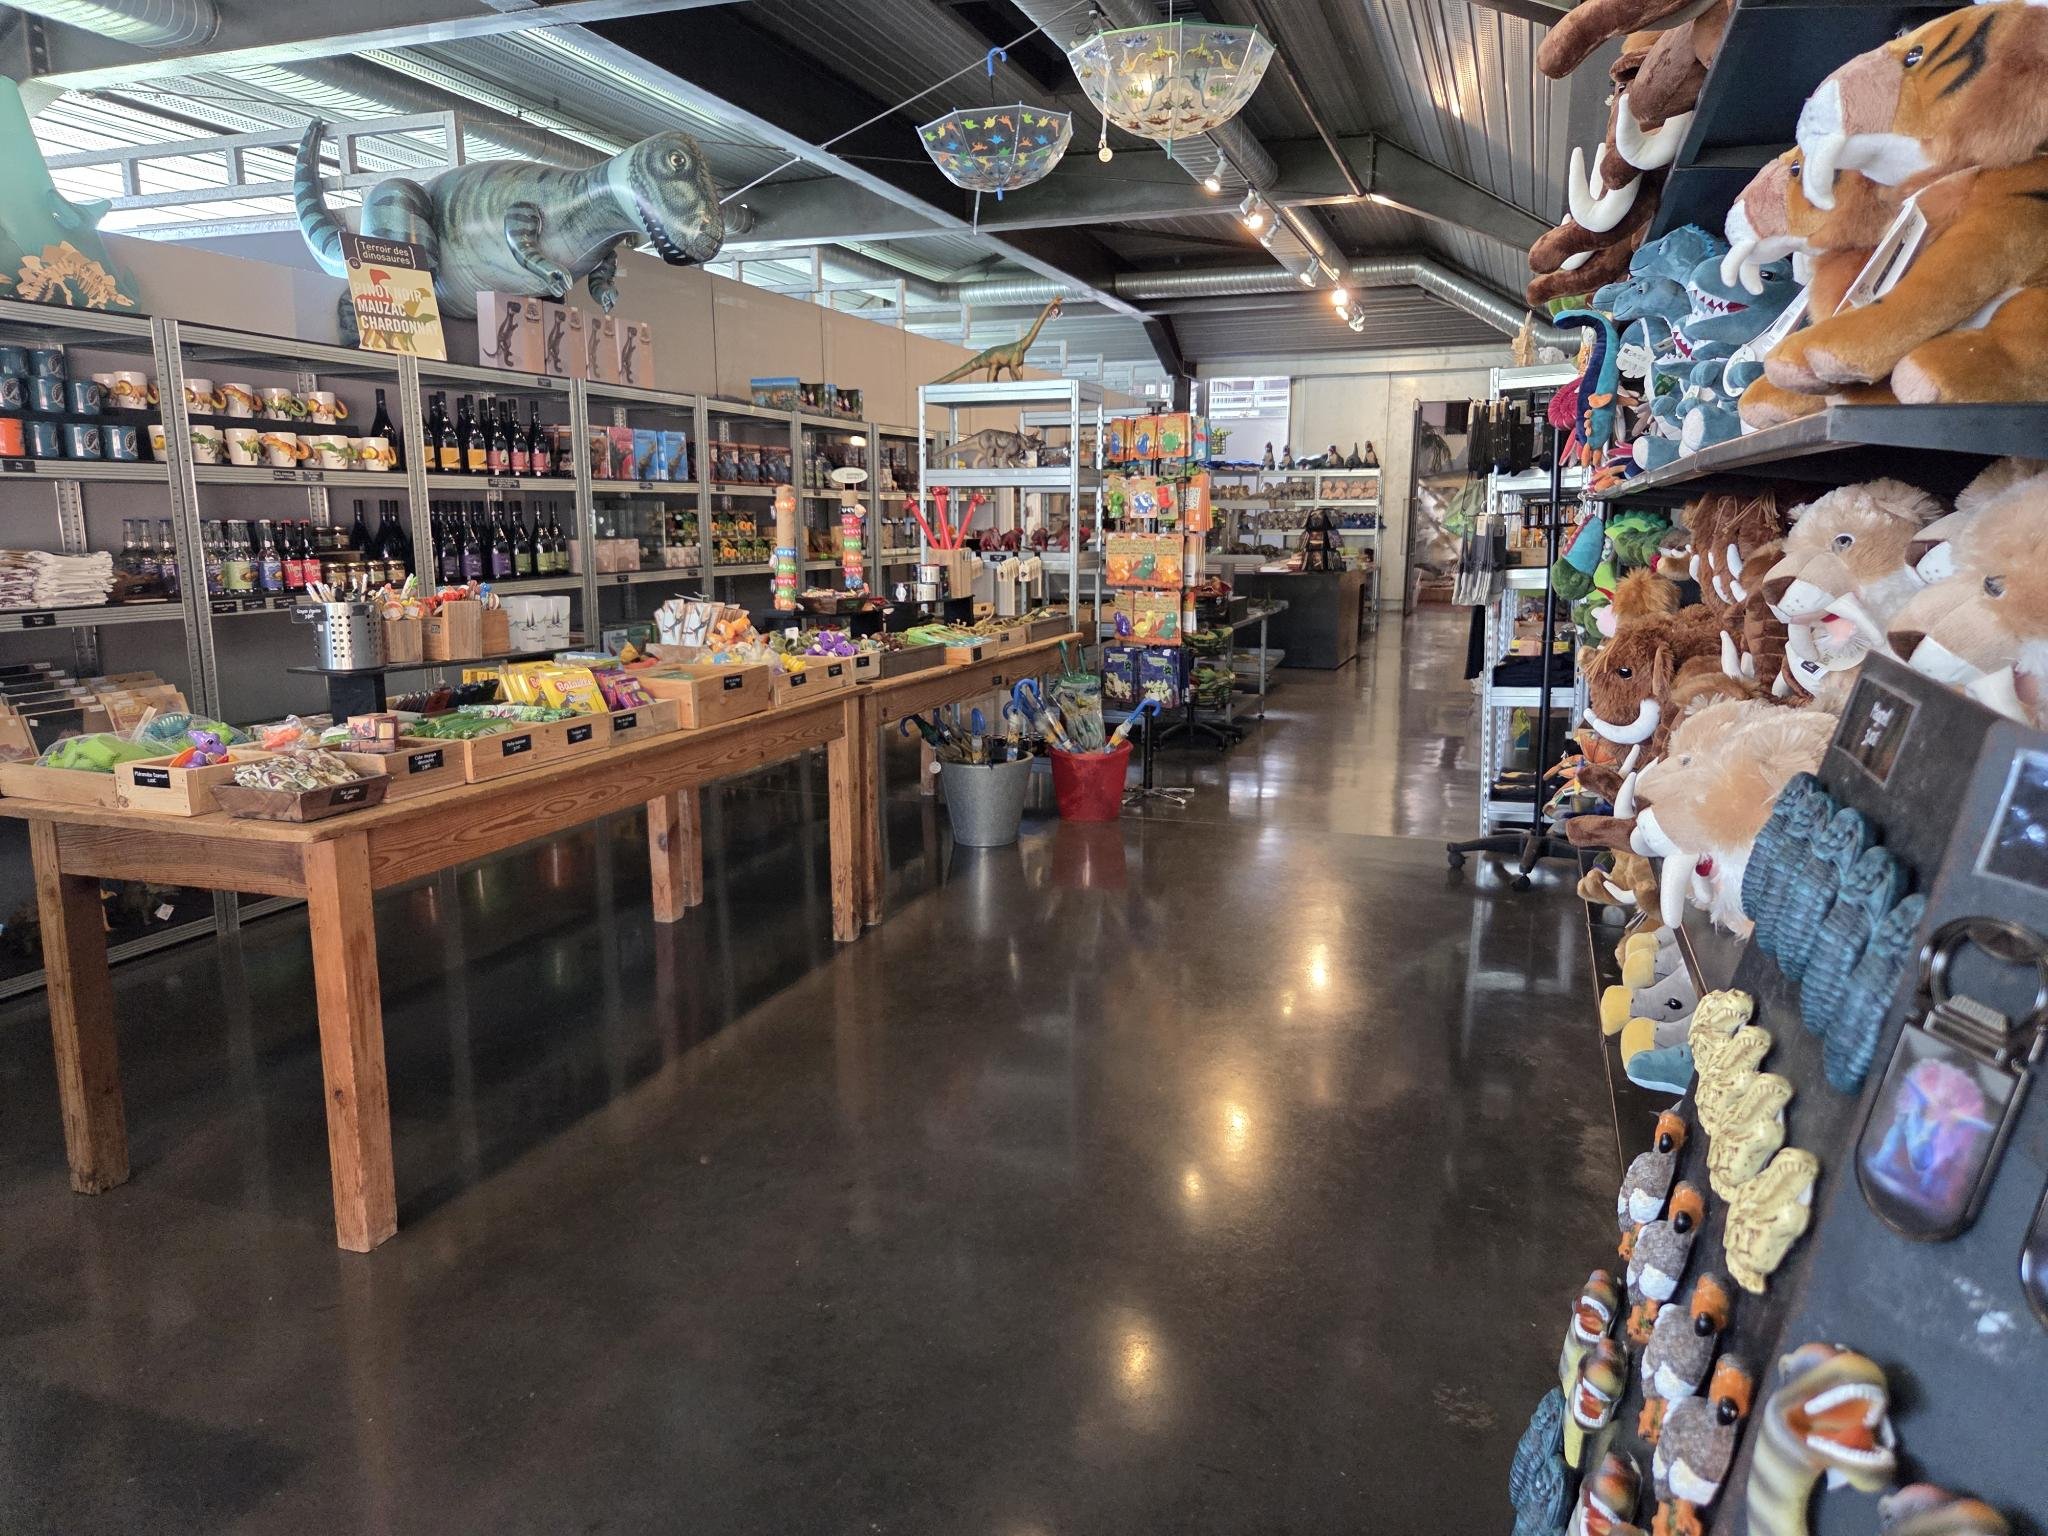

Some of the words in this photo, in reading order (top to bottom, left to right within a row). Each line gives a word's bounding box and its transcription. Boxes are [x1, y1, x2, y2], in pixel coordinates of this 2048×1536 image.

[360, 241, 391, 253] Terroir
[393, 247, 409, 257] des
[363, 251, 411, 264] dinosaures
[353, 281, 392, 299] PINOT
[393, 286, 423, 303] NOIR
[357, 298, 407, 317] MAUZAC
[361, 315, 437, 335] CHARDONNAY
